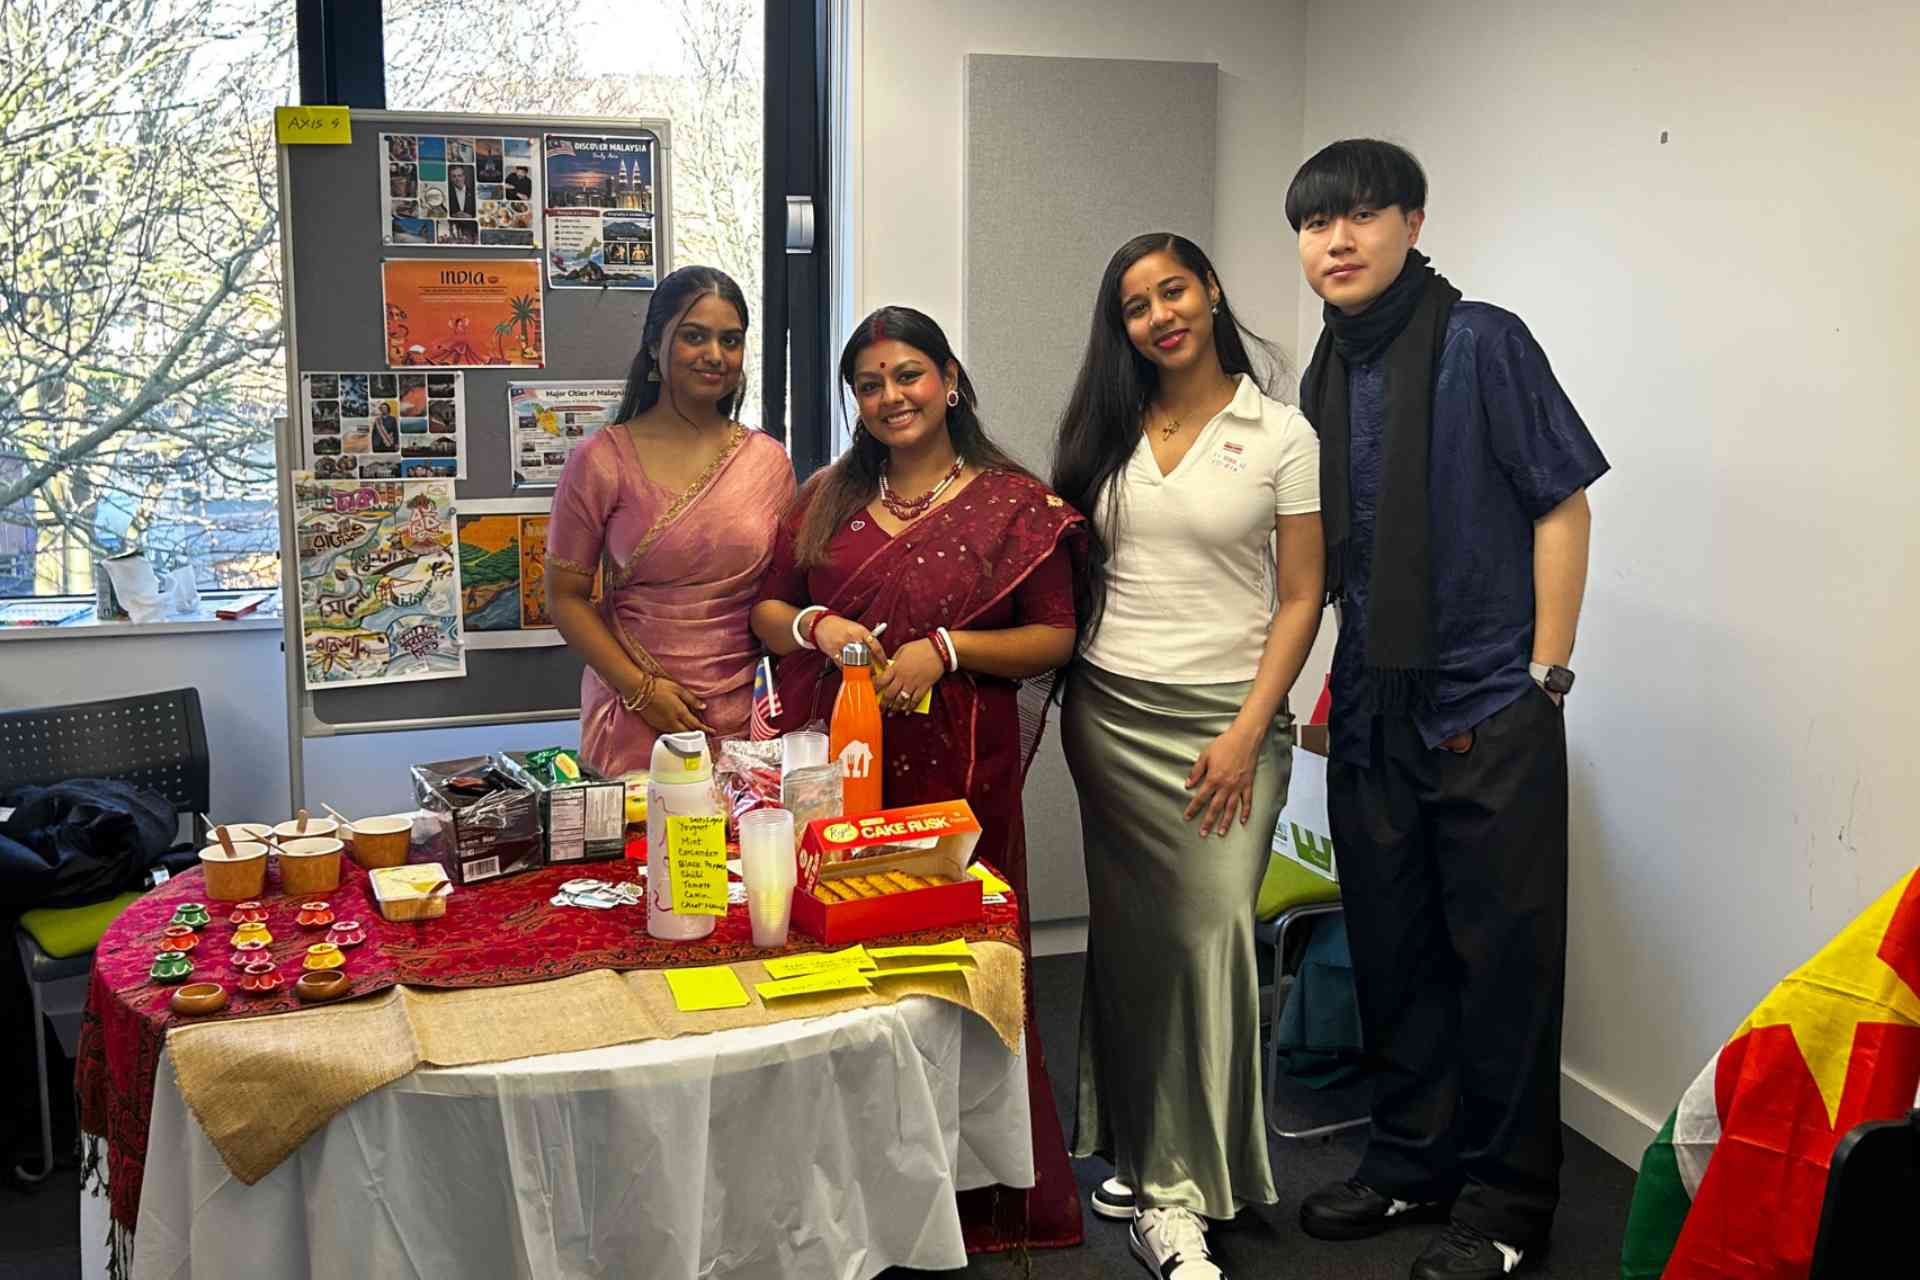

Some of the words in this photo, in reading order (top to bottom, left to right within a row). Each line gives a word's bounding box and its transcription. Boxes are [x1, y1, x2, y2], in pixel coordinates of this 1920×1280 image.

[287, 117, 324, 130] AXIS
[574, 142, 608, 151] DISCOVER
[609, 143, 647, 153] MALAYSIA
[545, 390, 565, 398] Major
[860, 822, 908, 839] CAKE
[906, 816, 952, 833] RUSK
